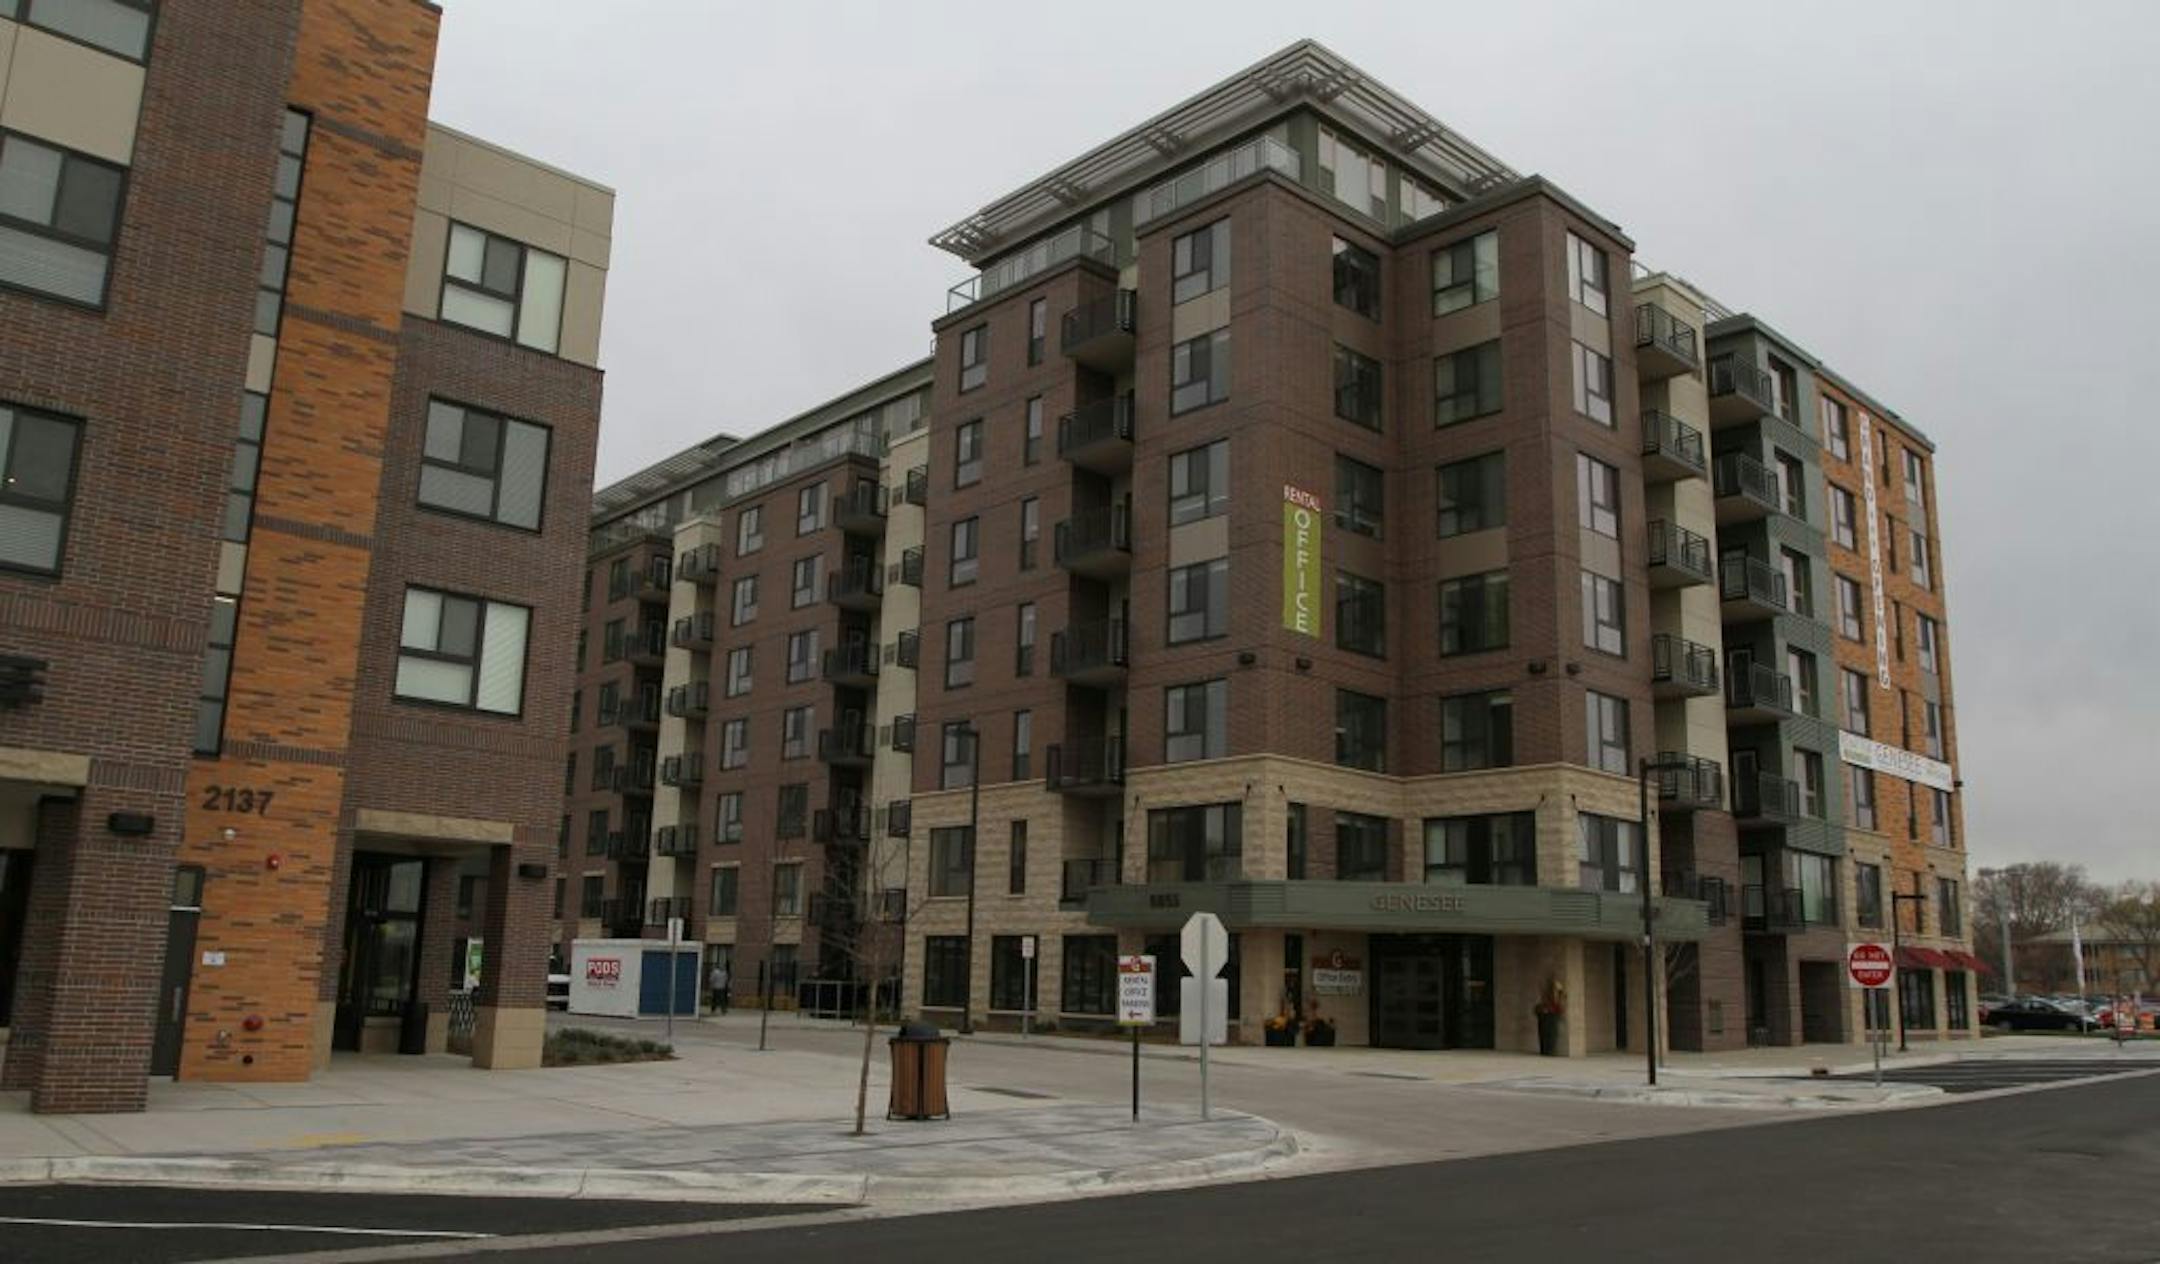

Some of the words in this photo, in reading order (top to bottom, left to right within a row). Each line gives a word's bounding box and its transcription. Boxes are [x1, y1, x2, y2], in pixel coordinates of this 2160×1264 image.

[1284, 484, 1321, 512] RENTAL
[1294, 508, 1311, 634] OFFICE
[202, 784, 275, 817] 2137
[1853, 950, 1866, 960] DO
[1868, 950, 1885, 960] NOT
[587, 961, 619, 976] PODS
[1857, 970, 1883, 980] ENTER
